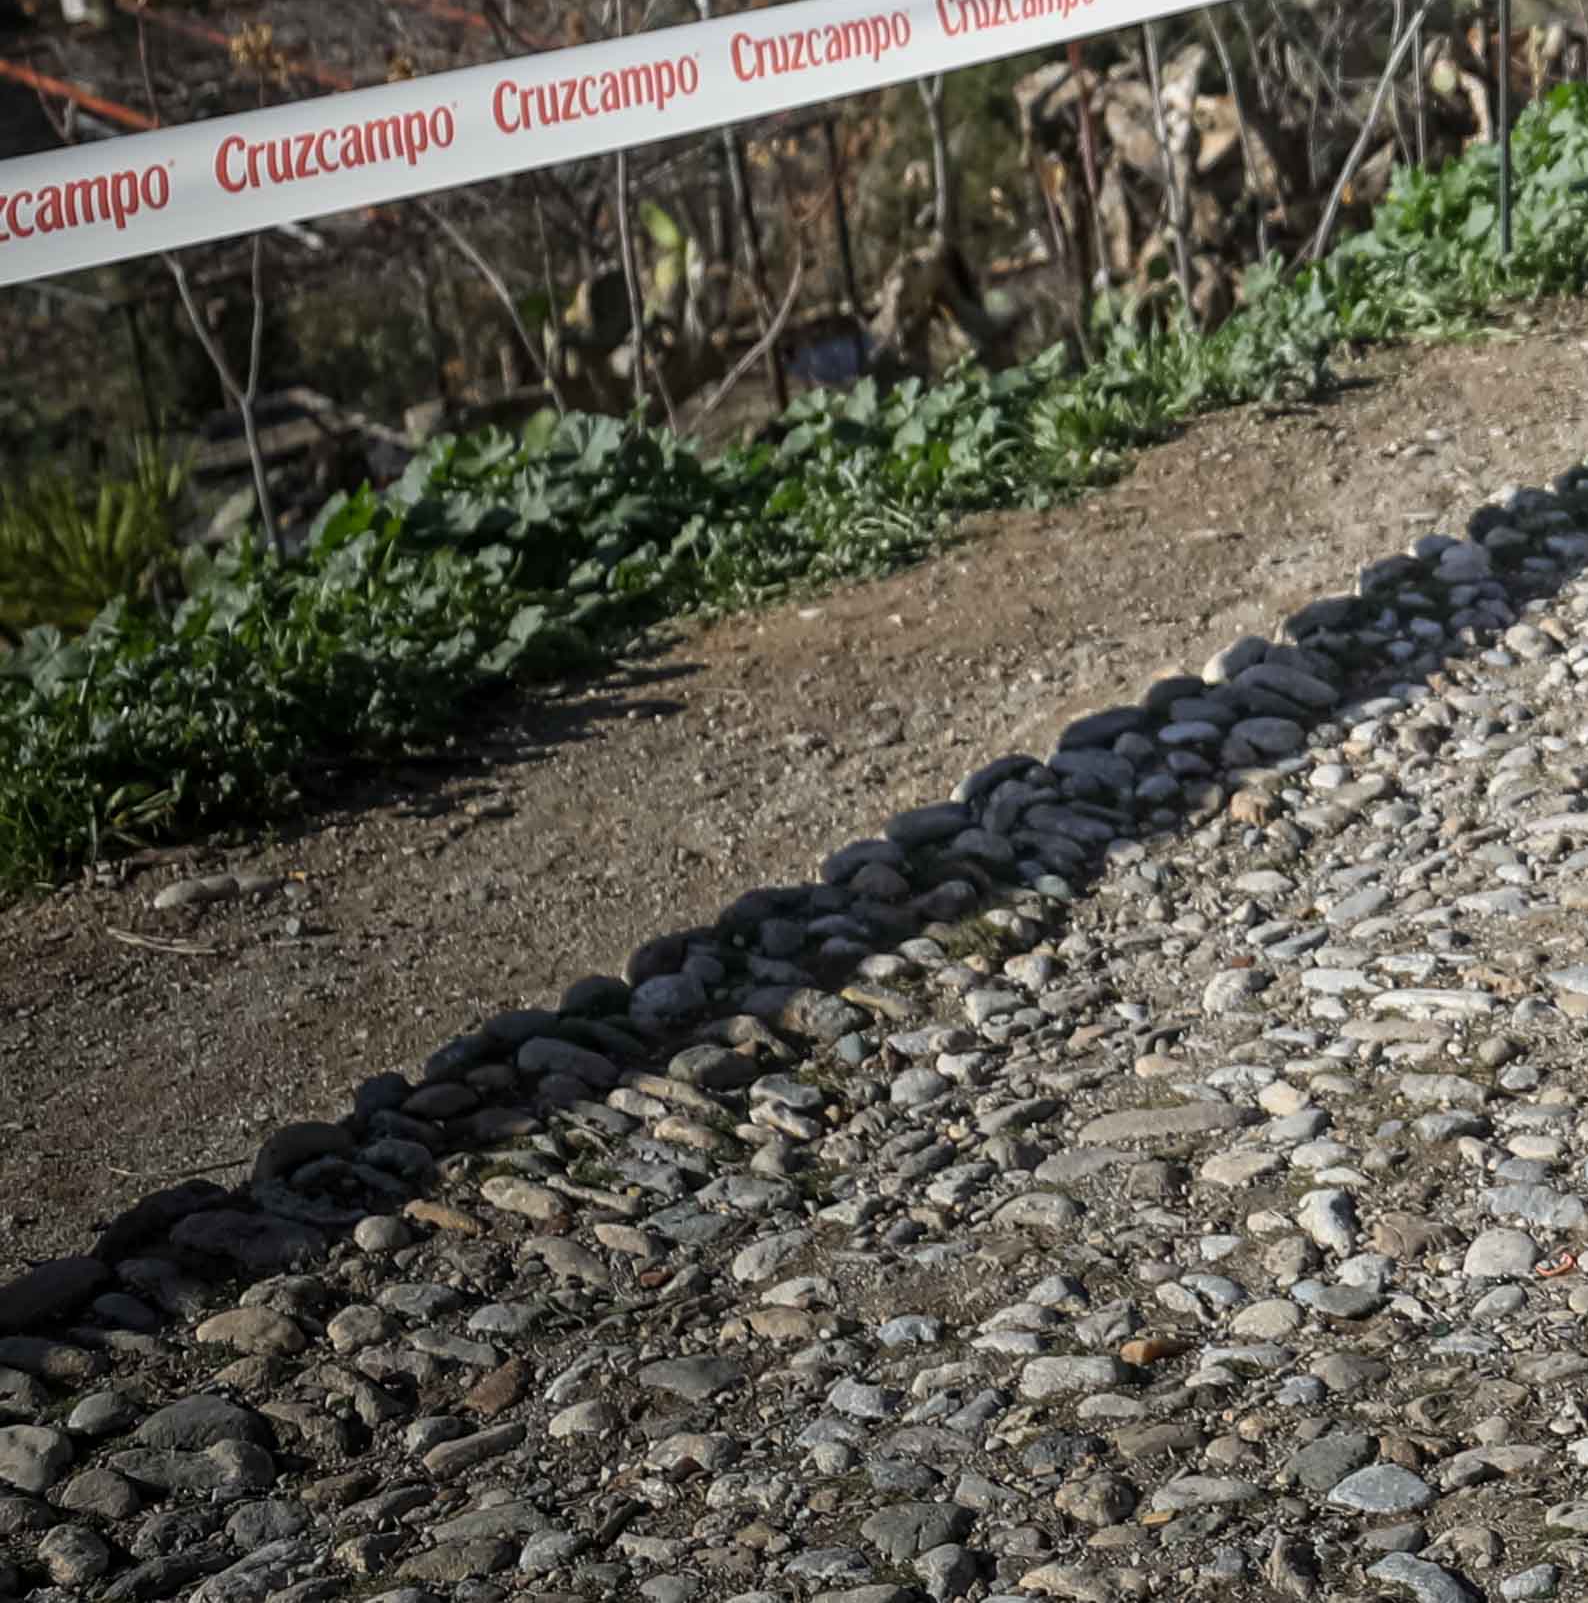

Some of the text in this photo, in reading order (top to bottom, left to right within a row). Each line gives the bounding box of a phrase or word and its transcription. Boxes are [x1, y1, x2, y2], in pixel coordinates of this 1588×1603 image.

[214, 105, 456, 194] Cruzcampo
[491, 54, 700, 135] Cruzcampo
[729, 10, 912, 82] Cruzcampo
